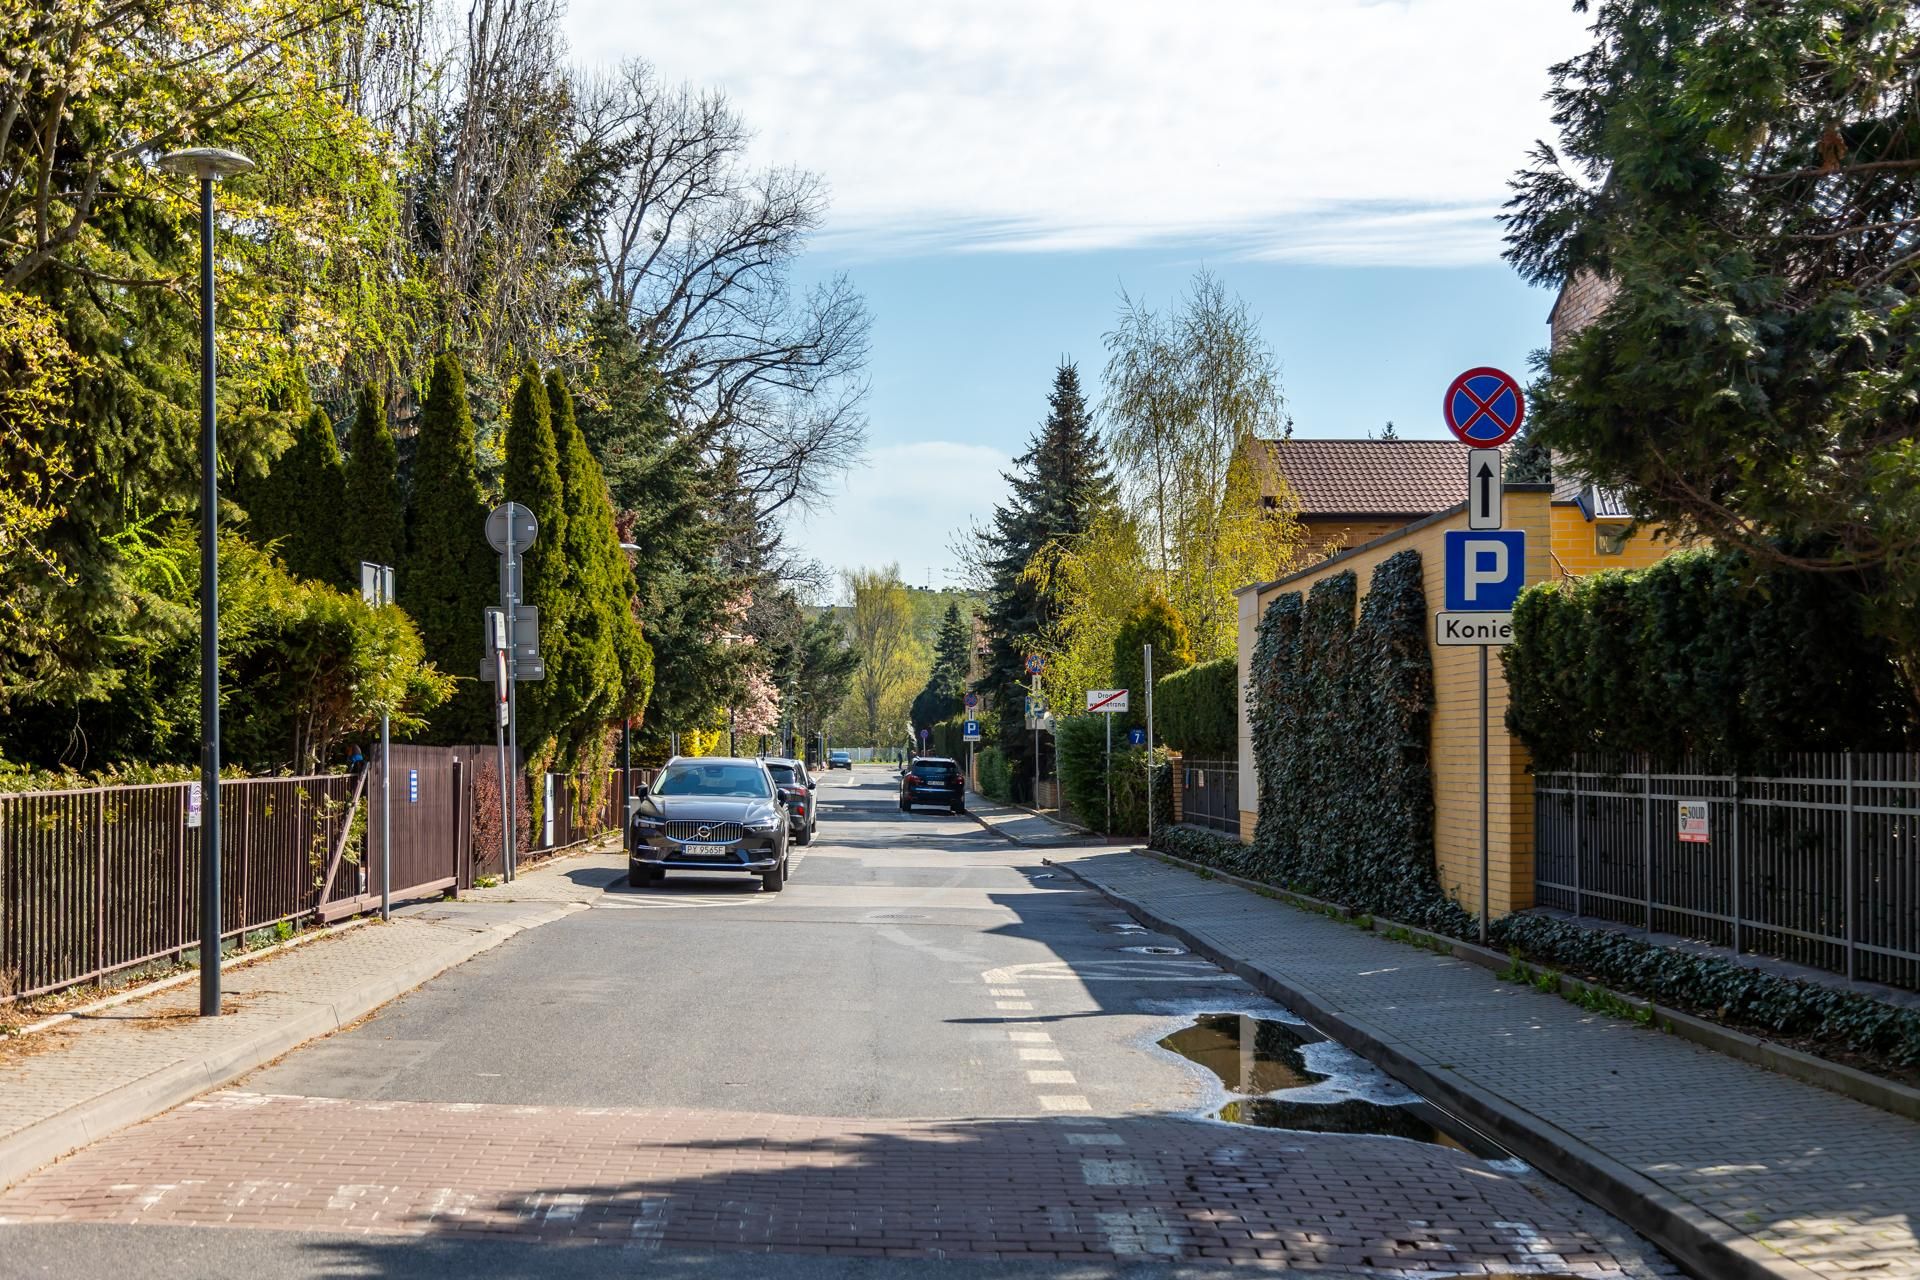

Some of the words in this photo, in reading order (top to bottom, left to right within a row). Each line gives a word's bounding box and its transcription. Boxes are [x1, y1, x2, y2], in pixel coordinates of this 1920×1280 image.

[1464, 540, 1508, 601] P
[1446, 620, 1512, 638] Konie
[968, 722, 976, 734] P
[1135, 733, 1140, 743] 7
[1688, 806, 1705, 819] SOLID
